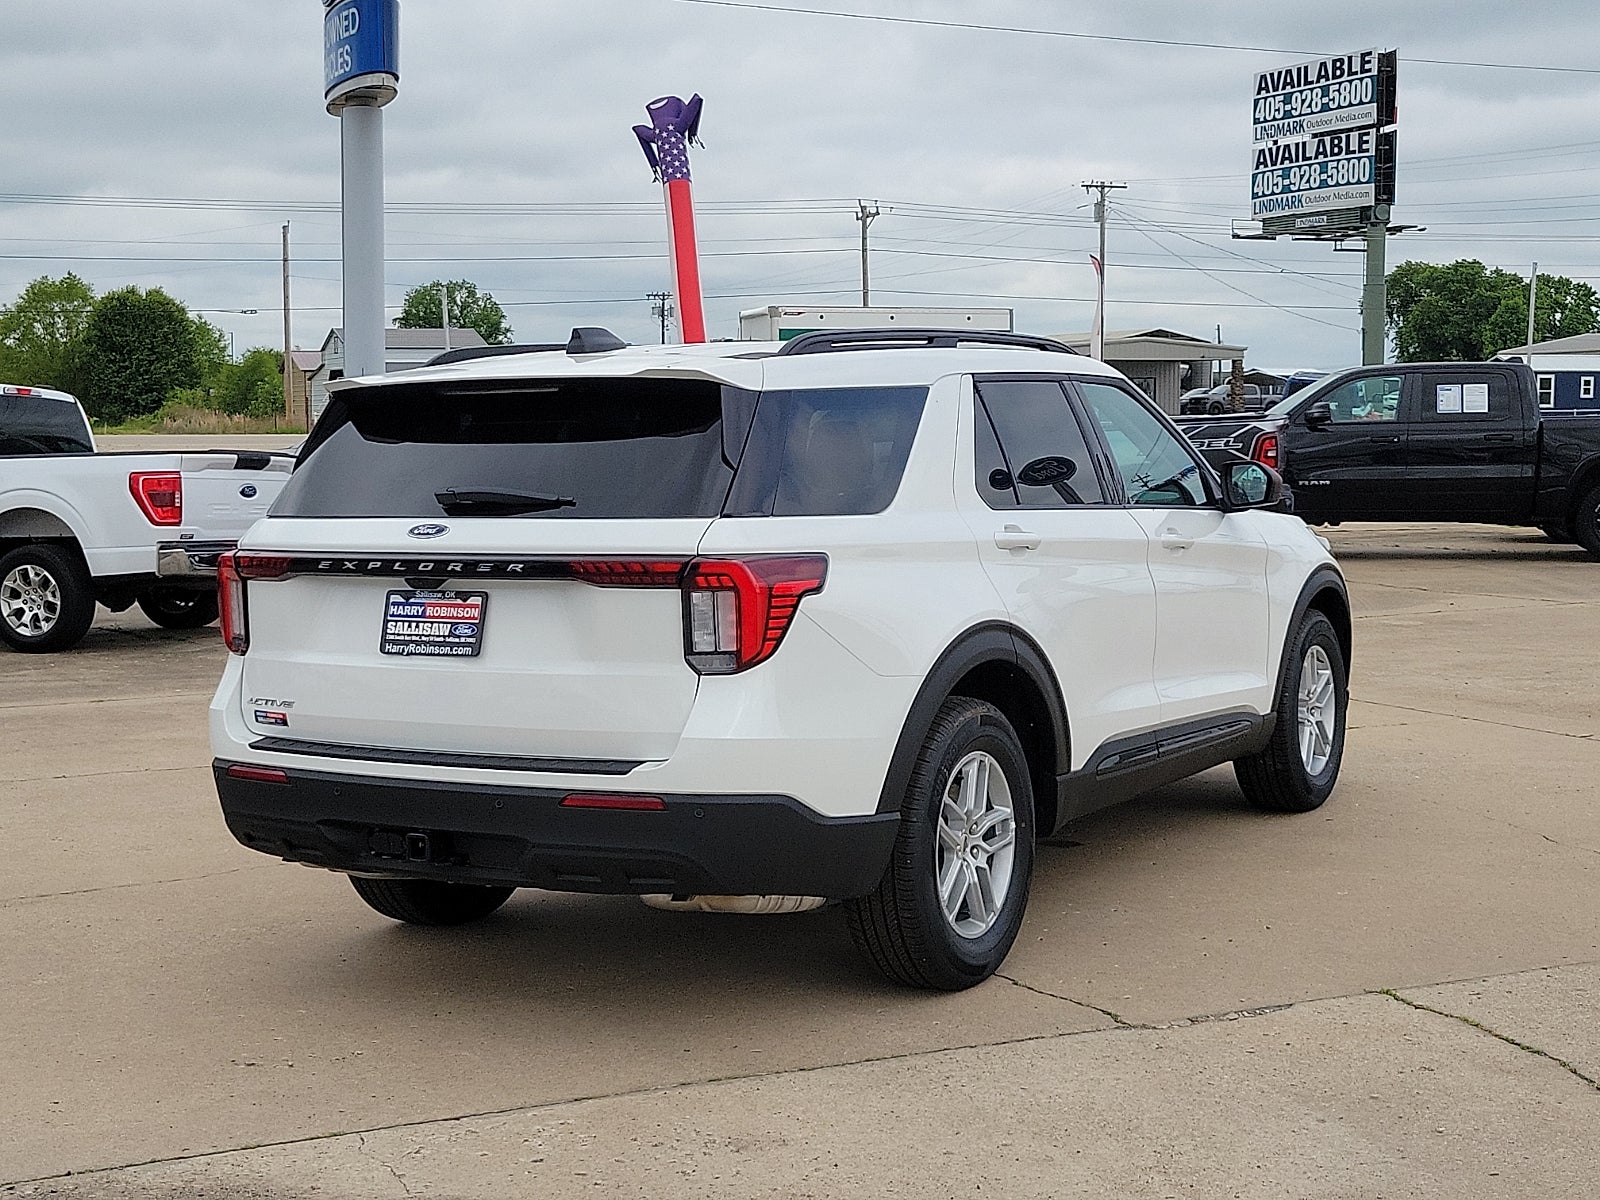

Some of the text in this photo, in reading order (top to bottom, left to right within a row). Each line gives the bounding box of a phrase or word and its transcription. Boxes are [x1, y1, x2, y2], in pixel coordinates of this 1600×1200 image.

[1256, 51, 1374, 96] AVAILABLE
[1254, 77, 1373, 122] 405-928-5800
[1254, 110, 1372, 141] LINDMARK Outdoor Media.com
[1255, 131, 1371, 170] AVAILABLE
[1253, 157, 1370, 196] 405-928-5800
[1254, 189, 1370, 215] LINDMARK Outdoor Media.com
[1296, 216, 1326, 227] LINDMARK
[317, 561, 525, 573] EXPLORER
[444, 591, 456, 599] OK
[390, 606, 479, 619] HARRY ROBINSON
[387, 621, 452, 636] SALLISAW
[384, 643, 473, 656] HarryRobinson.com
